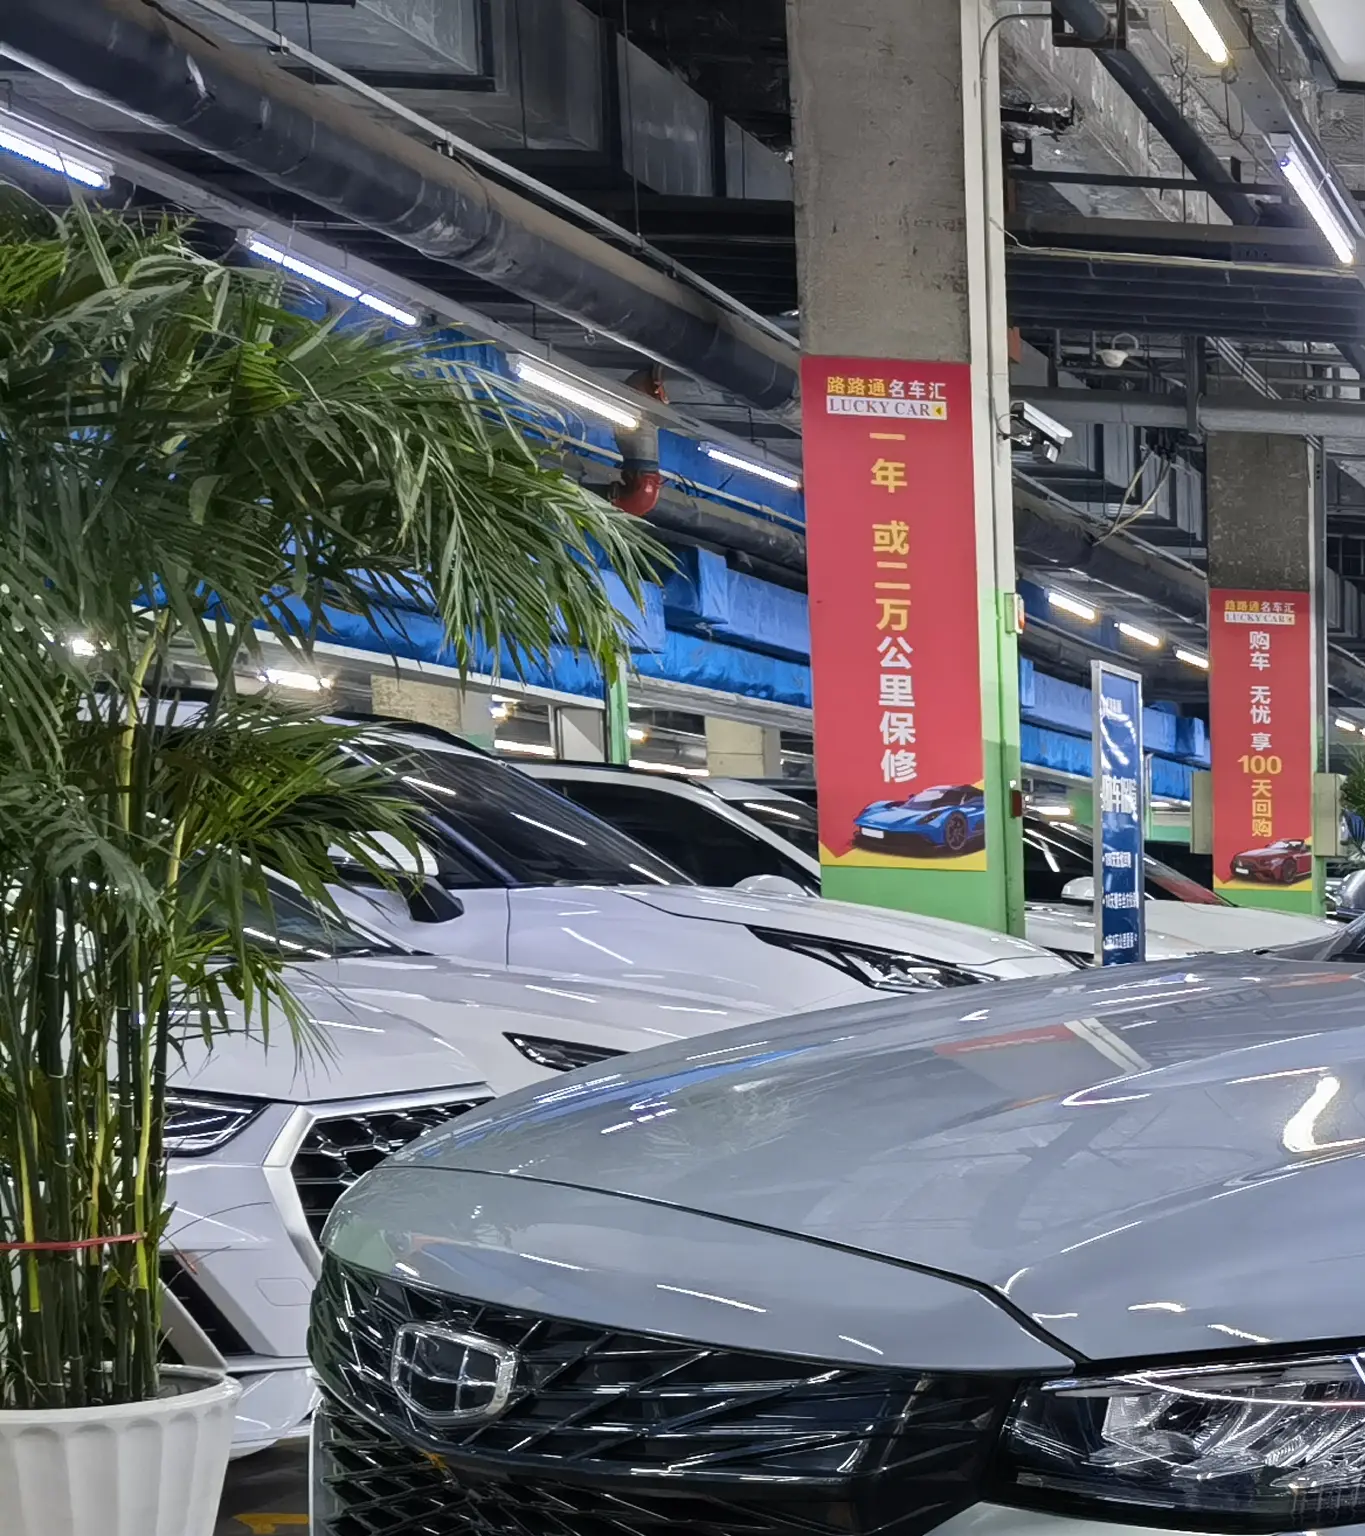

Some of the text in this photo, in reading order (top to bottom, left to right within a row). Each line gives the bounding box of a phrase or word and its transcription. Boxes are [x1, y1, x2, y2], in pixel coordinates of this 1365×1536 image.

[826, 376, 947, 400] 路路通名车汇
[829, 398, 931, 417] LUCKY CAR
[868, 431, 918, 784] 一年 或二万公里保修
[1226, 613, 1262, 622] LUCKY
[1249, 631, 1271, 671] 购车
[1249, 685, 1272, 724] 无忧
[1238, 754, 1282, 775] 100
[1251, 779, 1272, 837] 天回购
